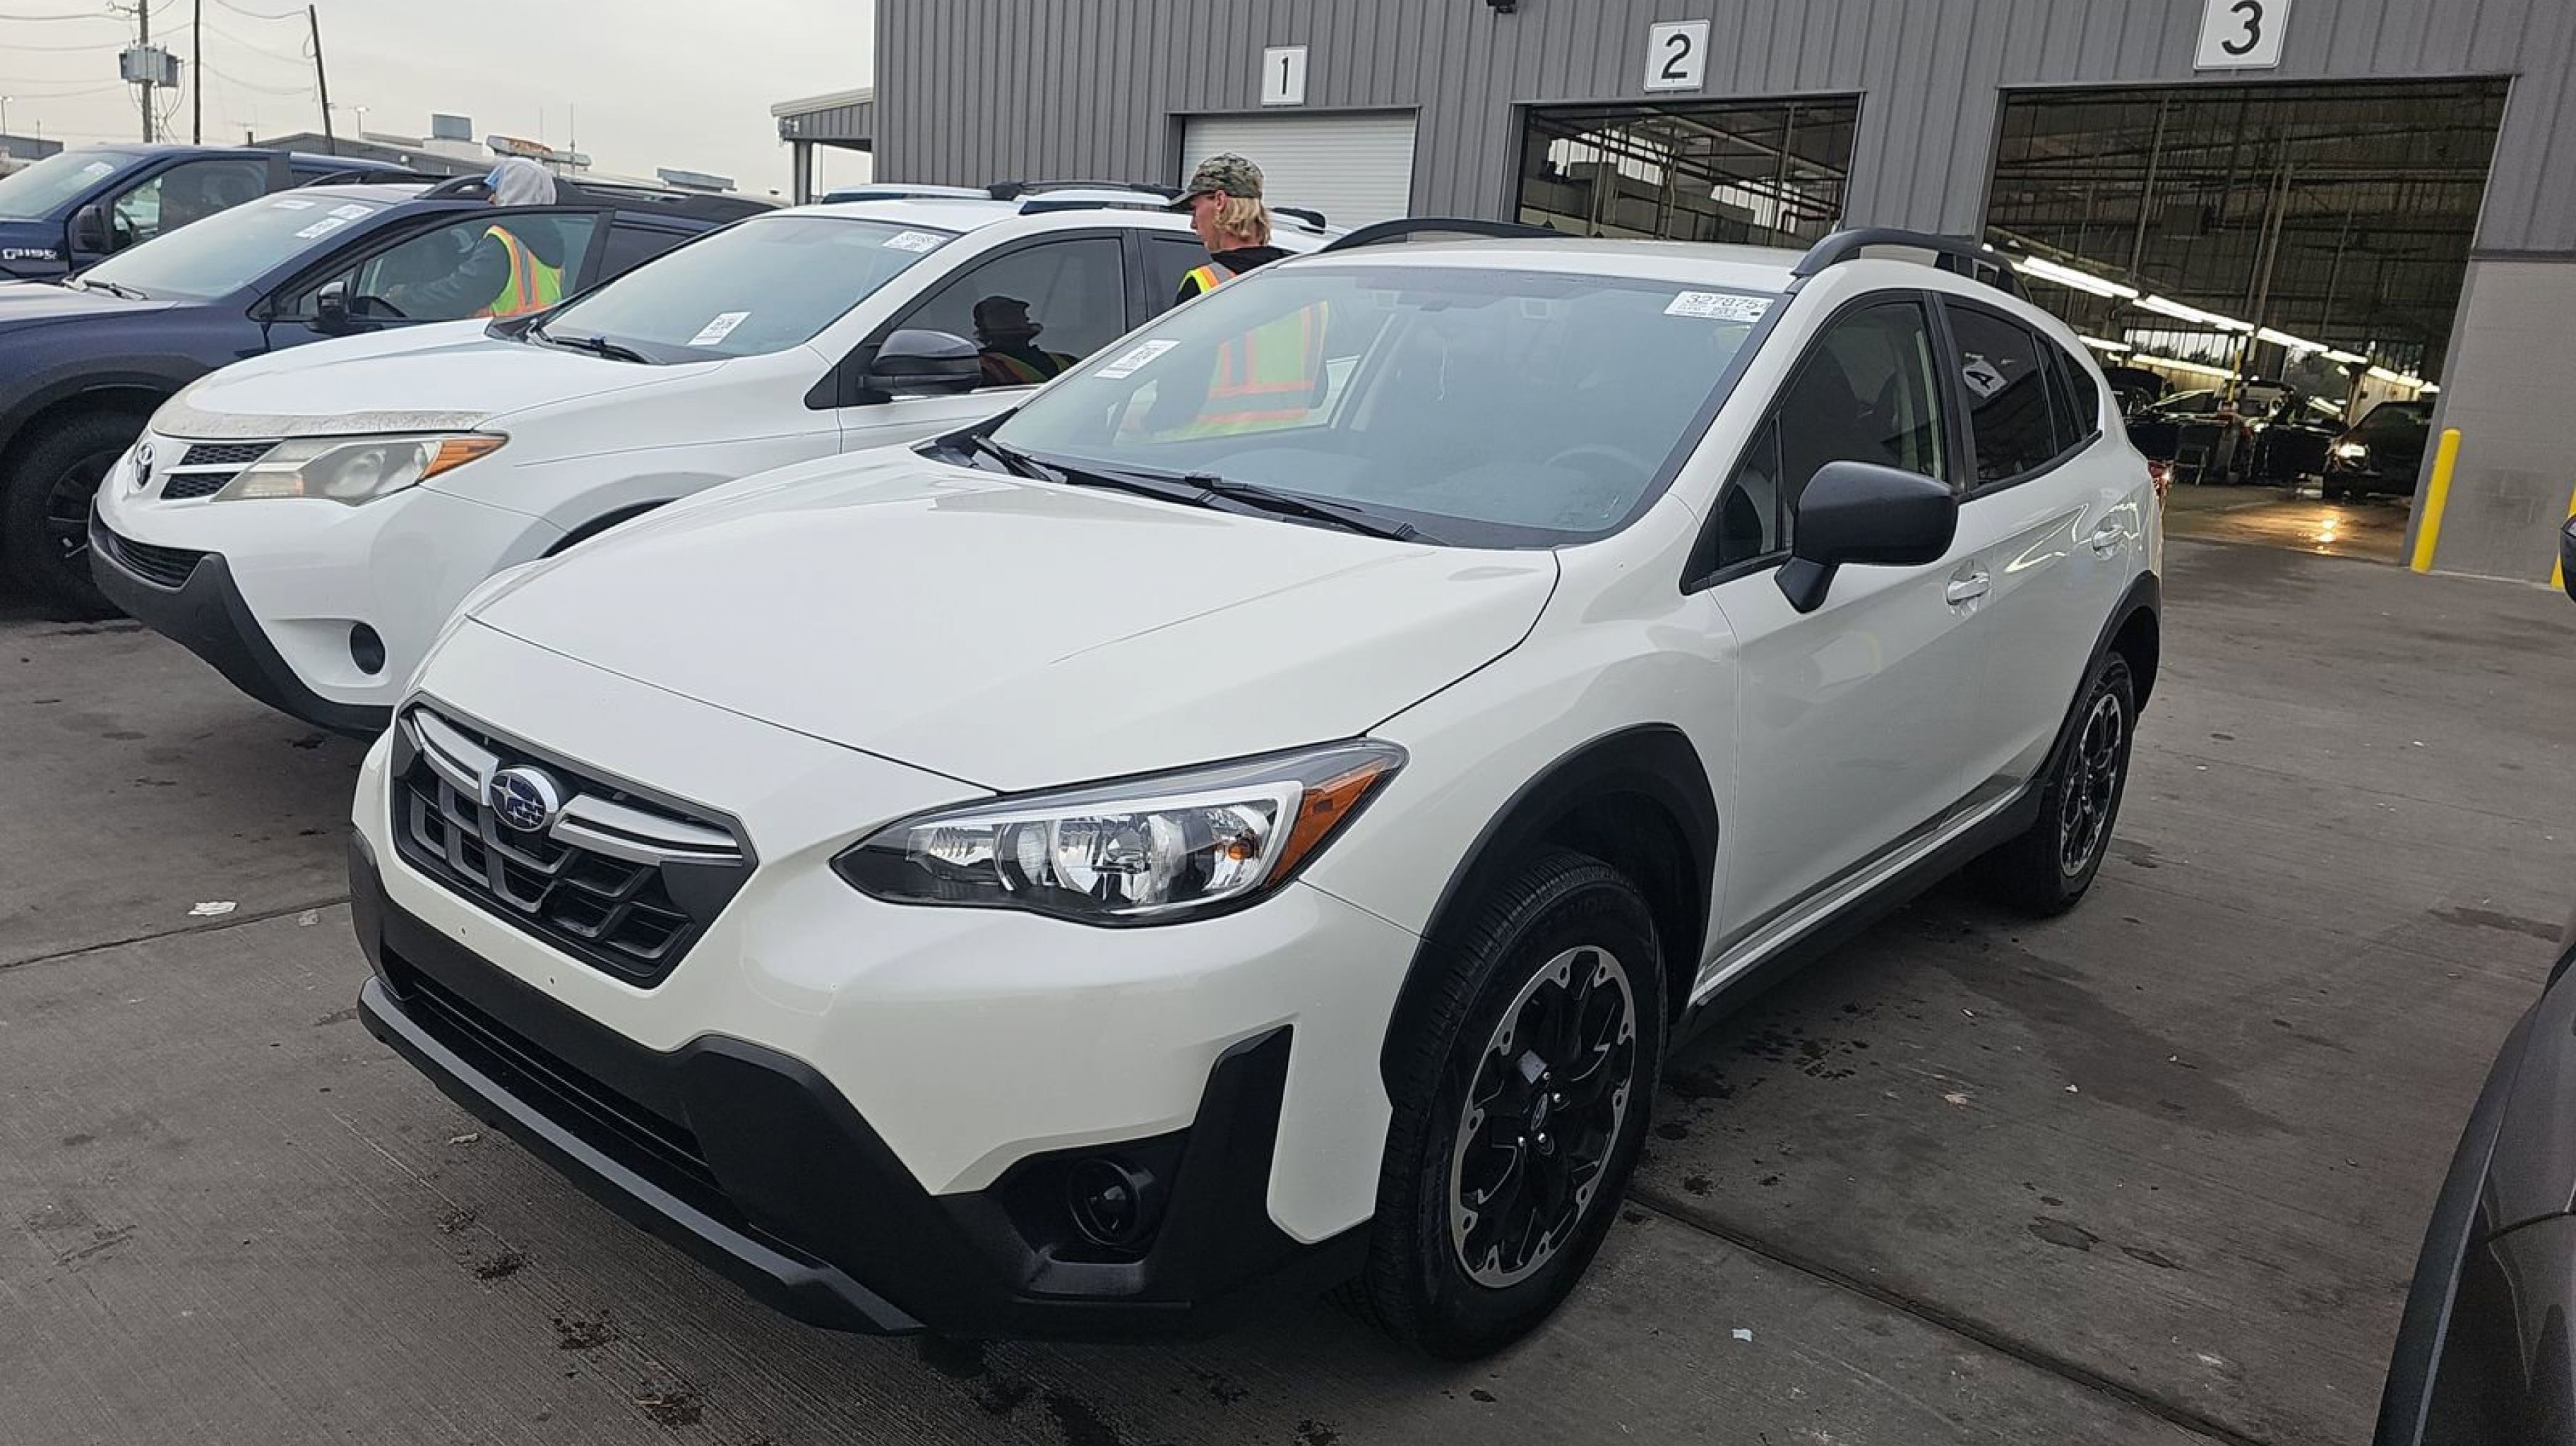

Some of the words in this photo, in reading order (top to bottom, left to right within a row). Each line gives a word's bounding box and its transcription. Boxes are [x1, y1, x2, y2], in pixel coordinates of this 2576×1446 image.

[2221, 1, 2263, 55] 3
[1281, 56, 1288, 95] 1
[1661, 33, 1691, 79] 2
